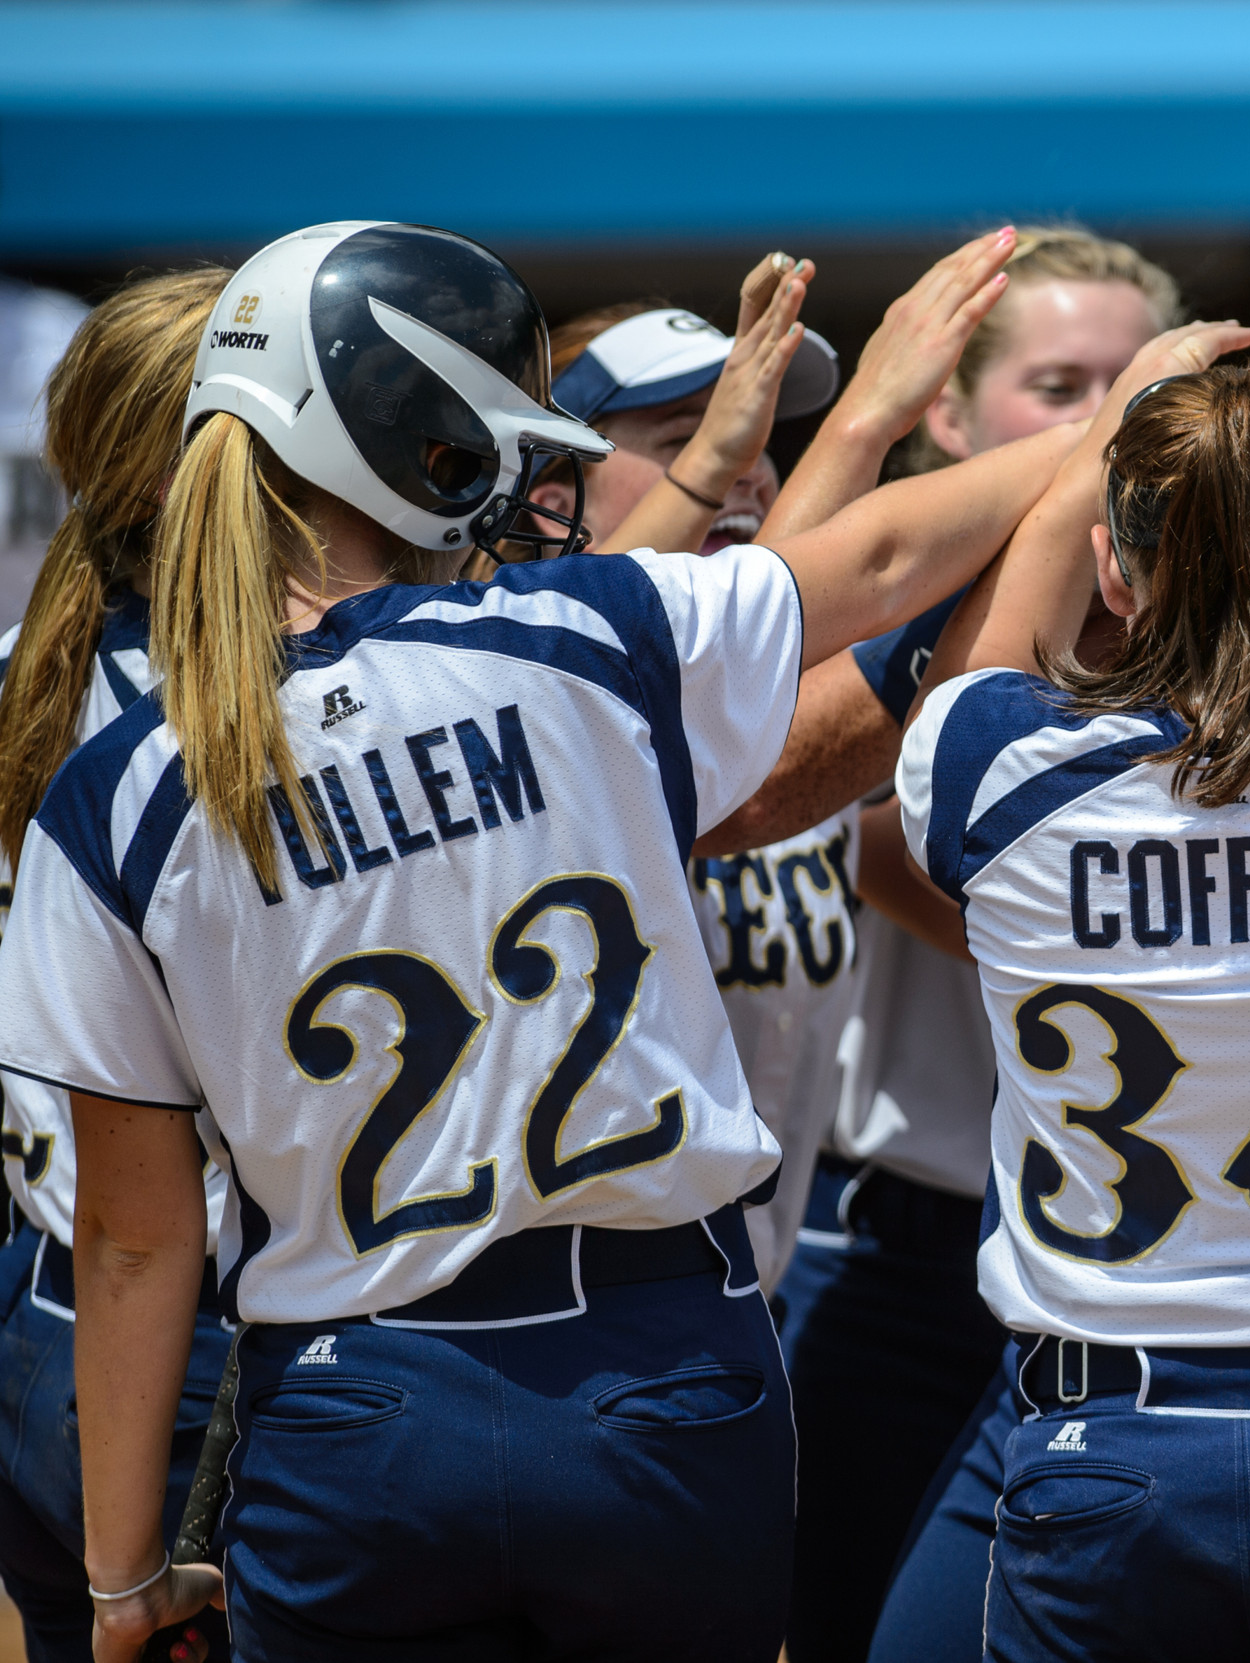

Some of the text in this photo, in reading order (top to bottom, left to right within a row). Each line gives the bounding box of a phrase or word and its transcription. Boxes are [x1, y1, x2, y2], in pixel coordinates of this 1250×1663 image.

[233, 295, 260, 324] 22
[218, 330, 269, 351] WORTH
[320, 700, 367, 732] RUSSELL
[283, 871, 689, 1261] 22
[296, 1353, 338, 1366] RUSSELL
[1046, 1440, 1087, 1452] RUSSELL
